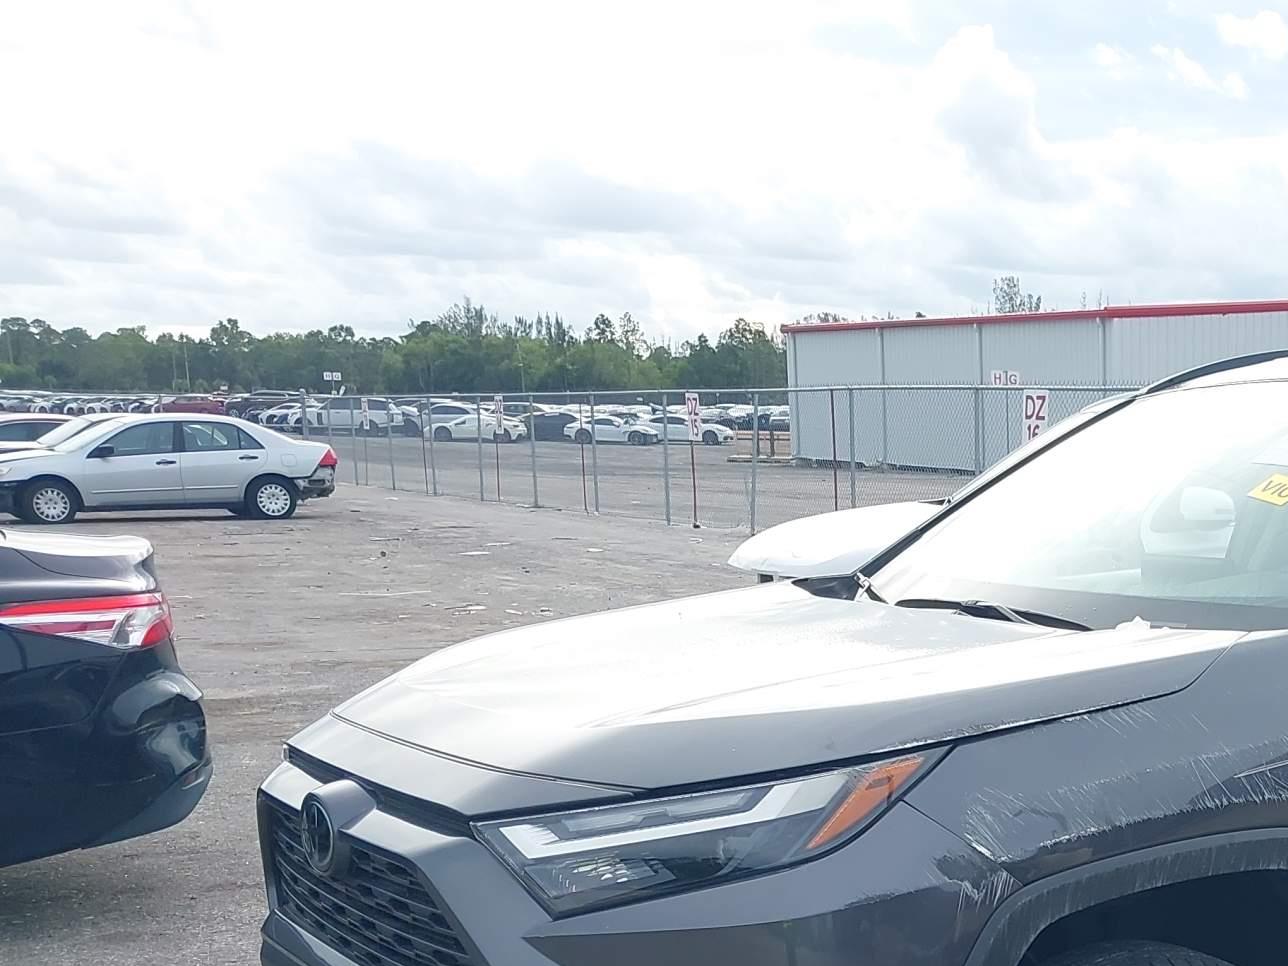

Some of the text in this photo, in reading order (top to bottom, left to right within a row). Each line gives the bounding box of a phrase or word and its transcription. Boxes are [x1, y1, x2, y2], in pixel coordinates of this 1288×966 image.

[994, 373, 1018, 385] H G
[687, 397, 699, 417] DZ
[1025, 395, 1046, 421] DZ
[691, 418, 699, 437] 15
